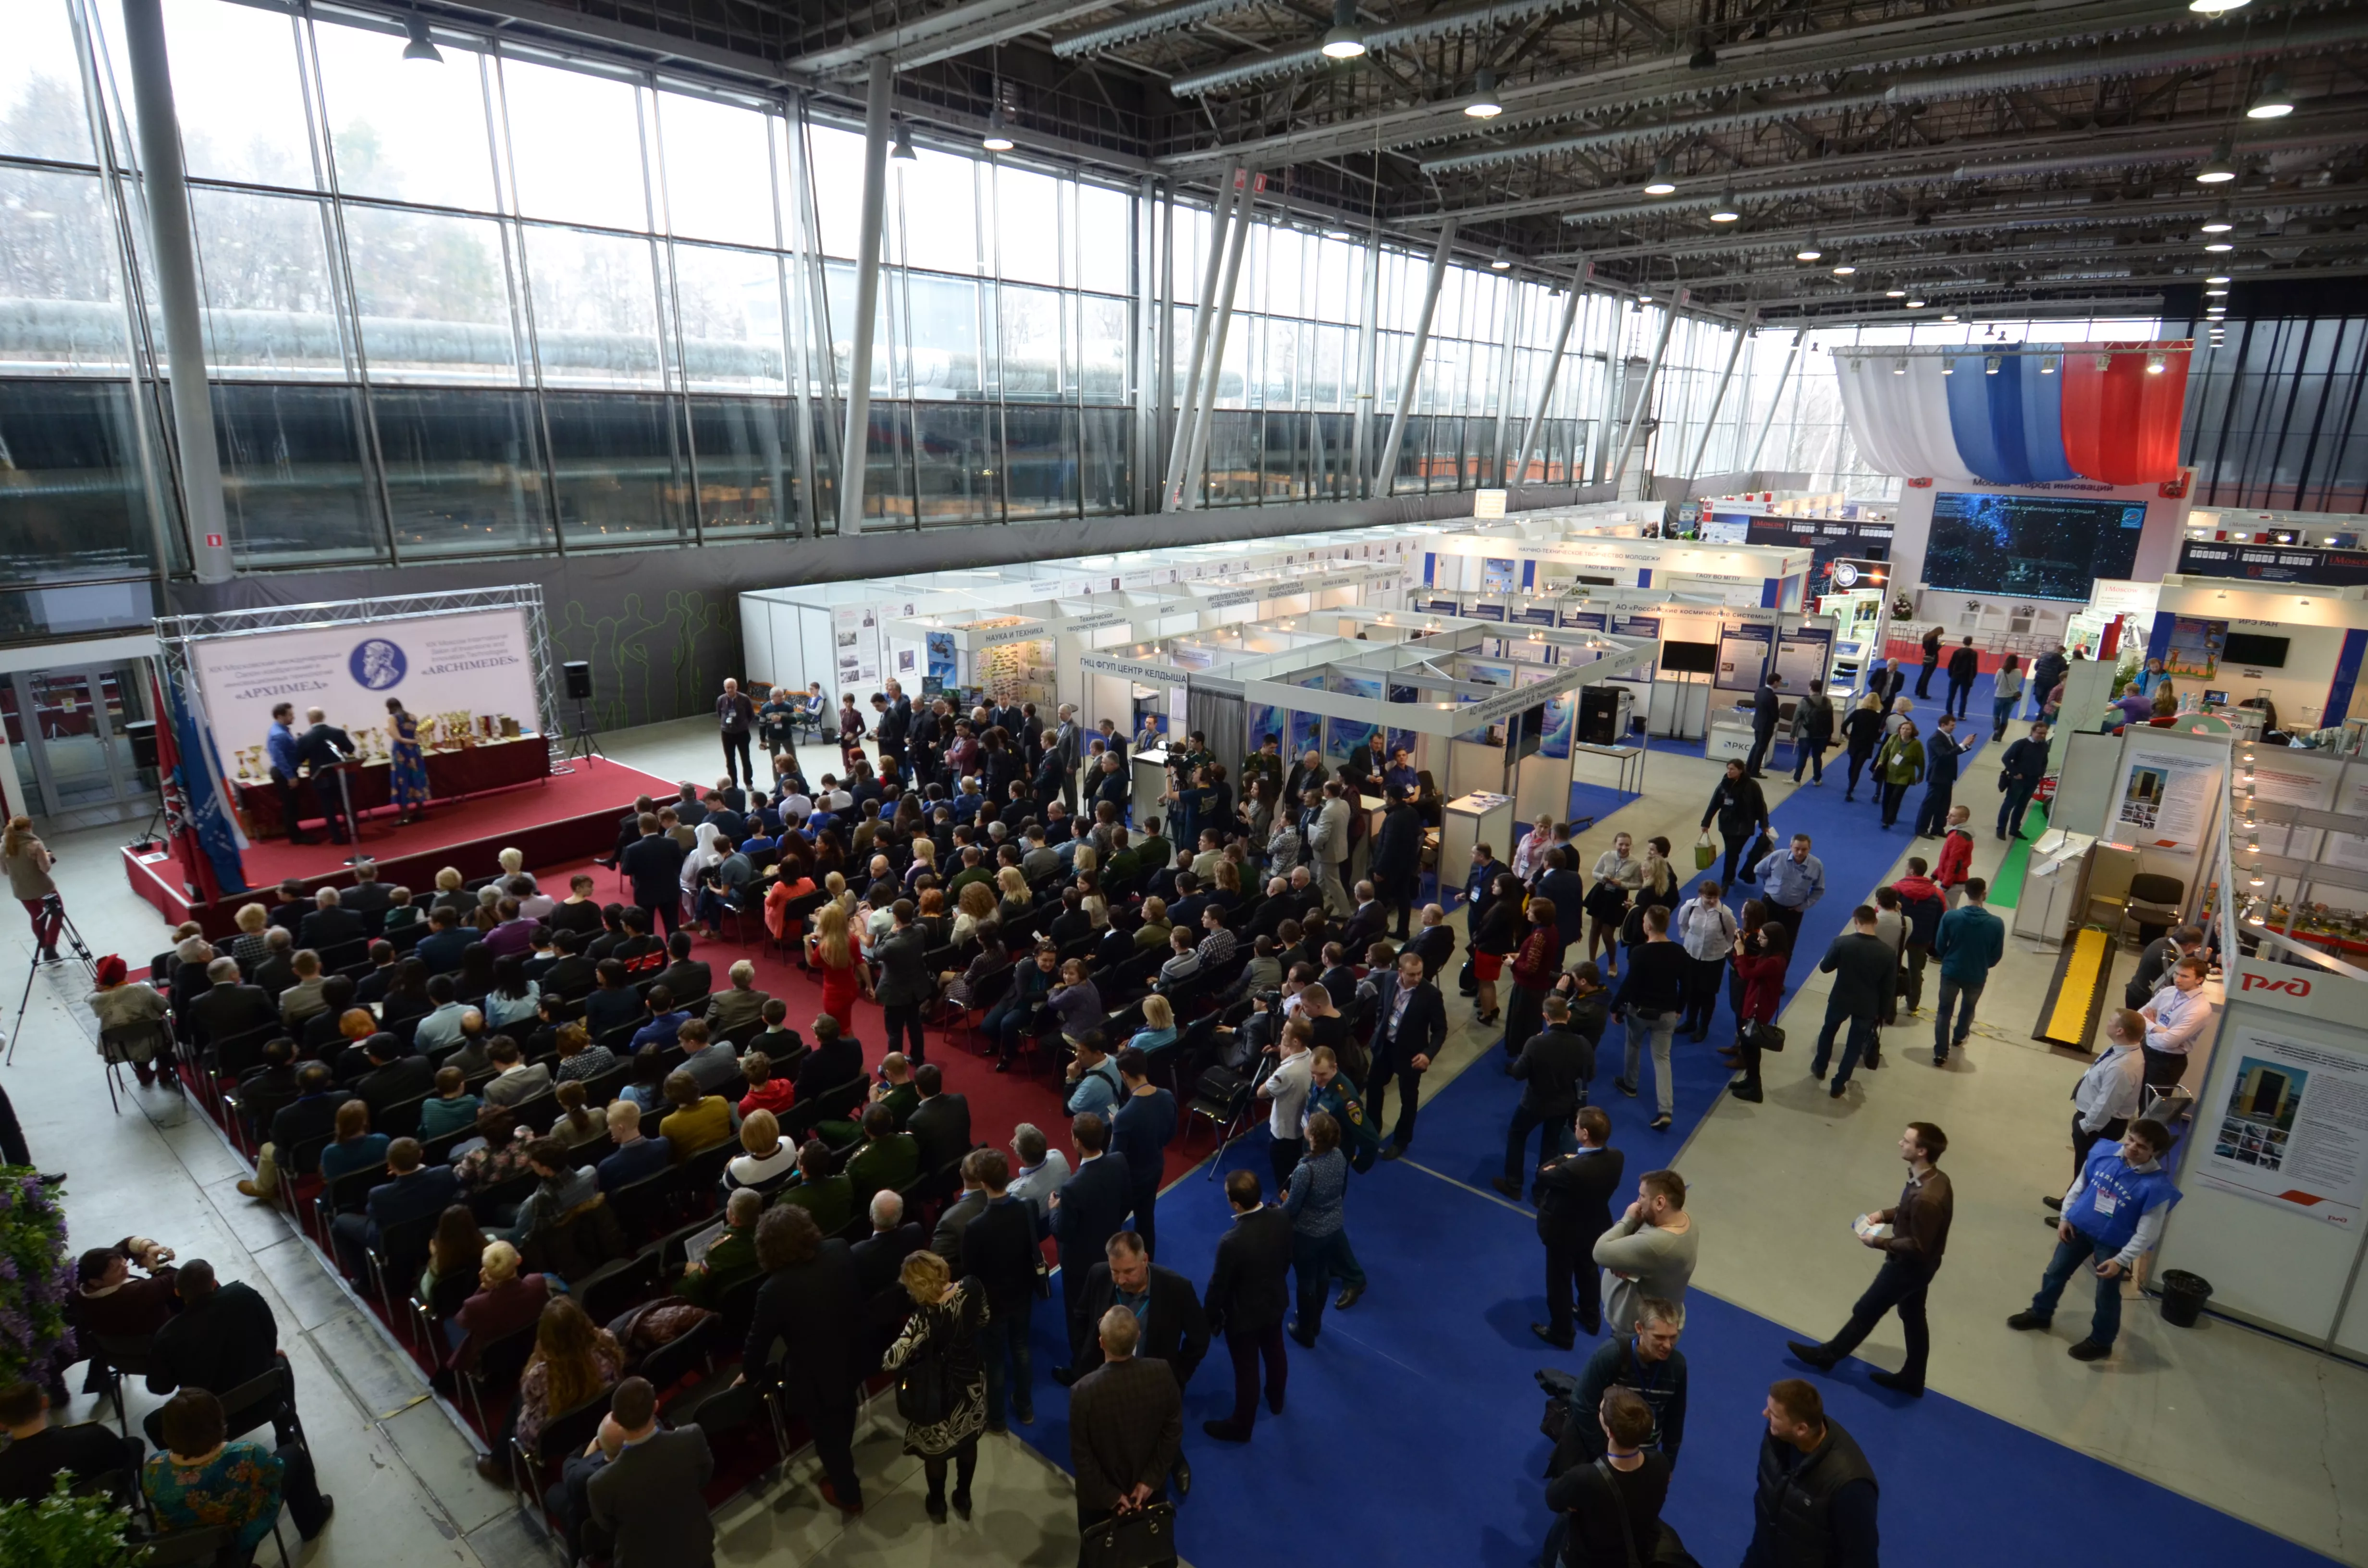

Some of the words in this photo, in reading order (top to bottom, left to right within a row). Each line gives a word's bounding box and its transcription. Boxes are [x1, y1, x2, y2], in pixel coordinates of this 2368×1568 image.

[2054, 482, 2114, 491] инноваций
[1269, 582, 1299, 592] ИЗОБРЕТАТЕЛЬ
[1208, 589, 1254, 602] ИНТЕЛЛЕКТУАЛЬНАЯ
[1268, 588, 1305, 599] РАЦИОНАЛИЗАТОР
[1211, 598, 1250, 608] СОБСТВЕННОСТЬ
[1079, 612, 1113, 623] Техническое
[1732, 612, 1772, 621] системы»
[1067, 622, 1098, 632] творчество
[1099, 618, 1126, 627] молодежи
[986, 632, 1008, 642] НАУКА
[1016, 627, 1044, 637] ТЕХНИКА
[421, 656, 519, 675] «ARCHIMEDES»
[1080, 658, 1095, 668] ГНЦ
[1096, 661, 1116, 671] ФГУП
[1118, 664, 1143, 675] ЦЕНТР
[1145, 669, 1187, 683] КЕЛДЫША
[235, 680, 329, 699] «АРХИМЕД»
[1469, 706, 1477, 717] АО
[1732, 742, 1750, 751] РКС
